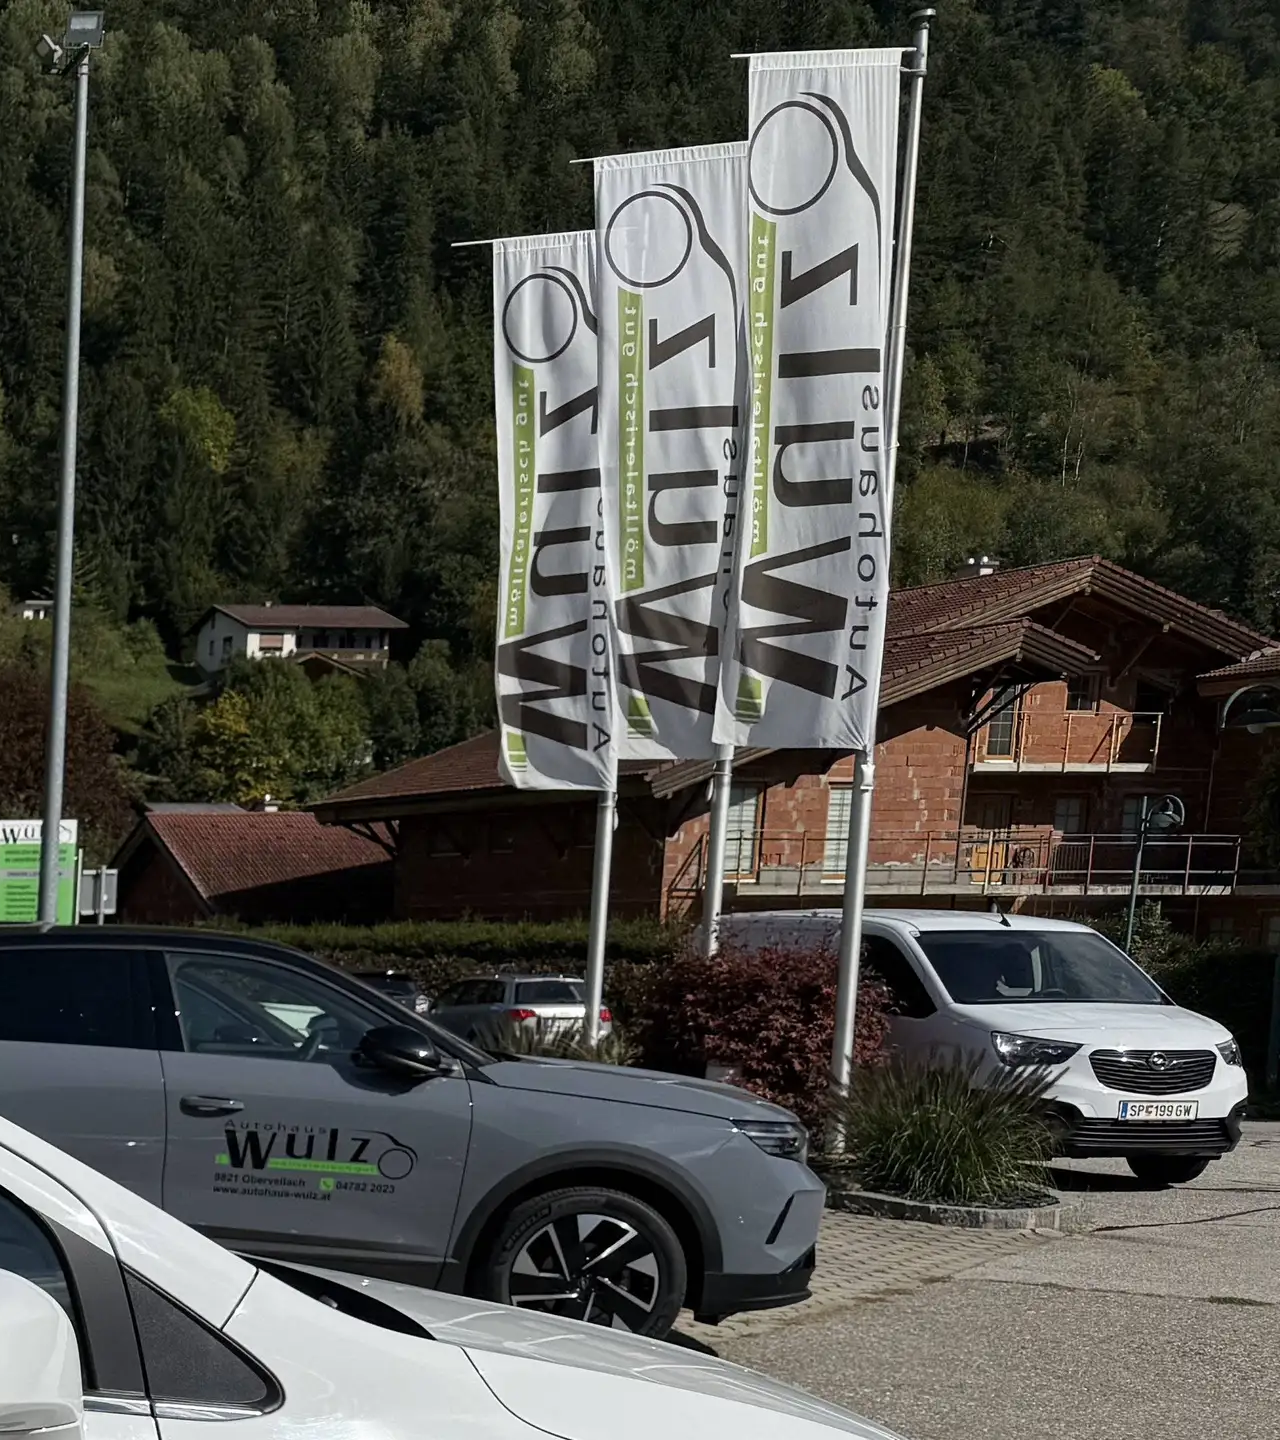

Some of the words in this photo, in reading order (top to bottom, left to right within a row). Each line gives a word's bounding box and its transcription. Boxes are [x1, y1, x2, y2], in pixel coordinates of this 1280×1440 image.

[1129, 1104, 1145, 1117] SP
[1154, 1104, 1174, 1117] 199
[1175, 1104, 1192, 1117] GW
[224, 1119, 327, 1134] Autohaus
[224, 1128, 371, 1170] Wulz
